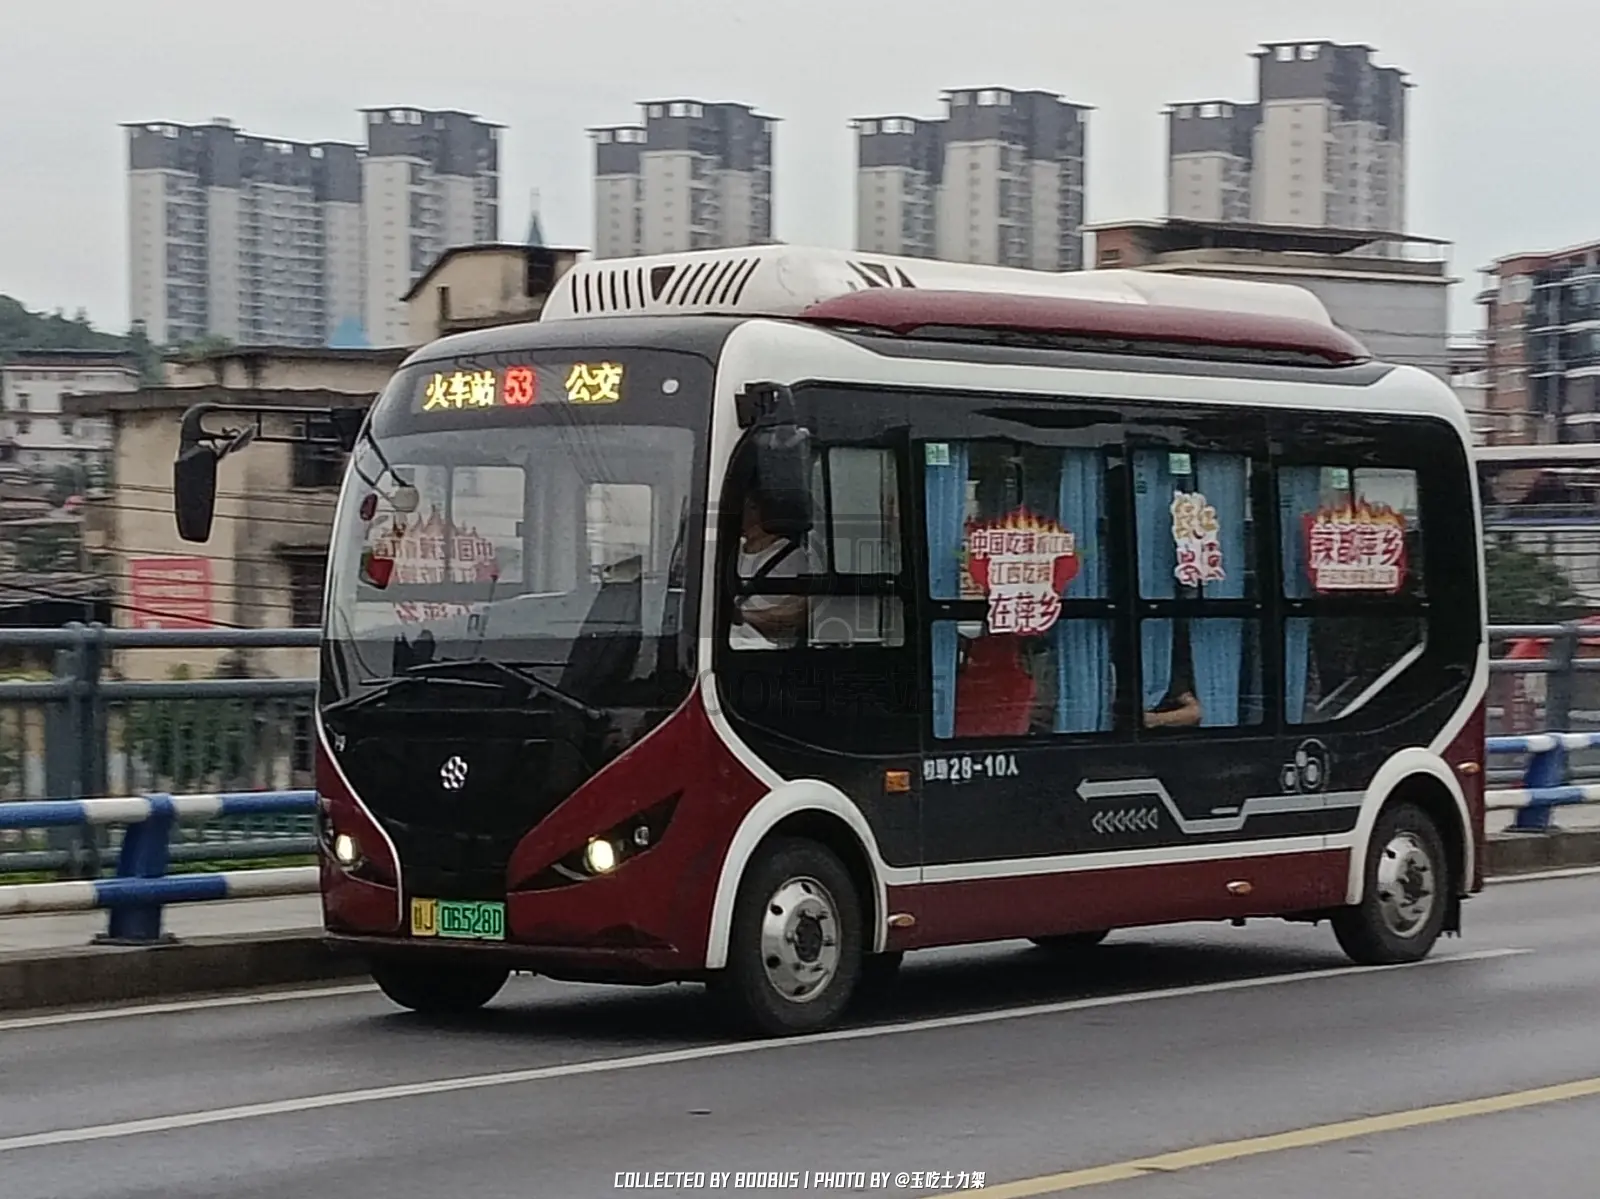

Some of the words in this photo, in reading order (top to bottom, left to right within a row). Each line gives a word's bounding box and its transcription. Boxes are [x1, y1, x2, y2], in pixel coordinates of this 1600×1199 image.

[423, 370, 496, 411] 火车站
[504, 366, 535, 404] 53
[565, 363, 623, 402] 公交
[989, 592, 1061, 632] 在萍乡
